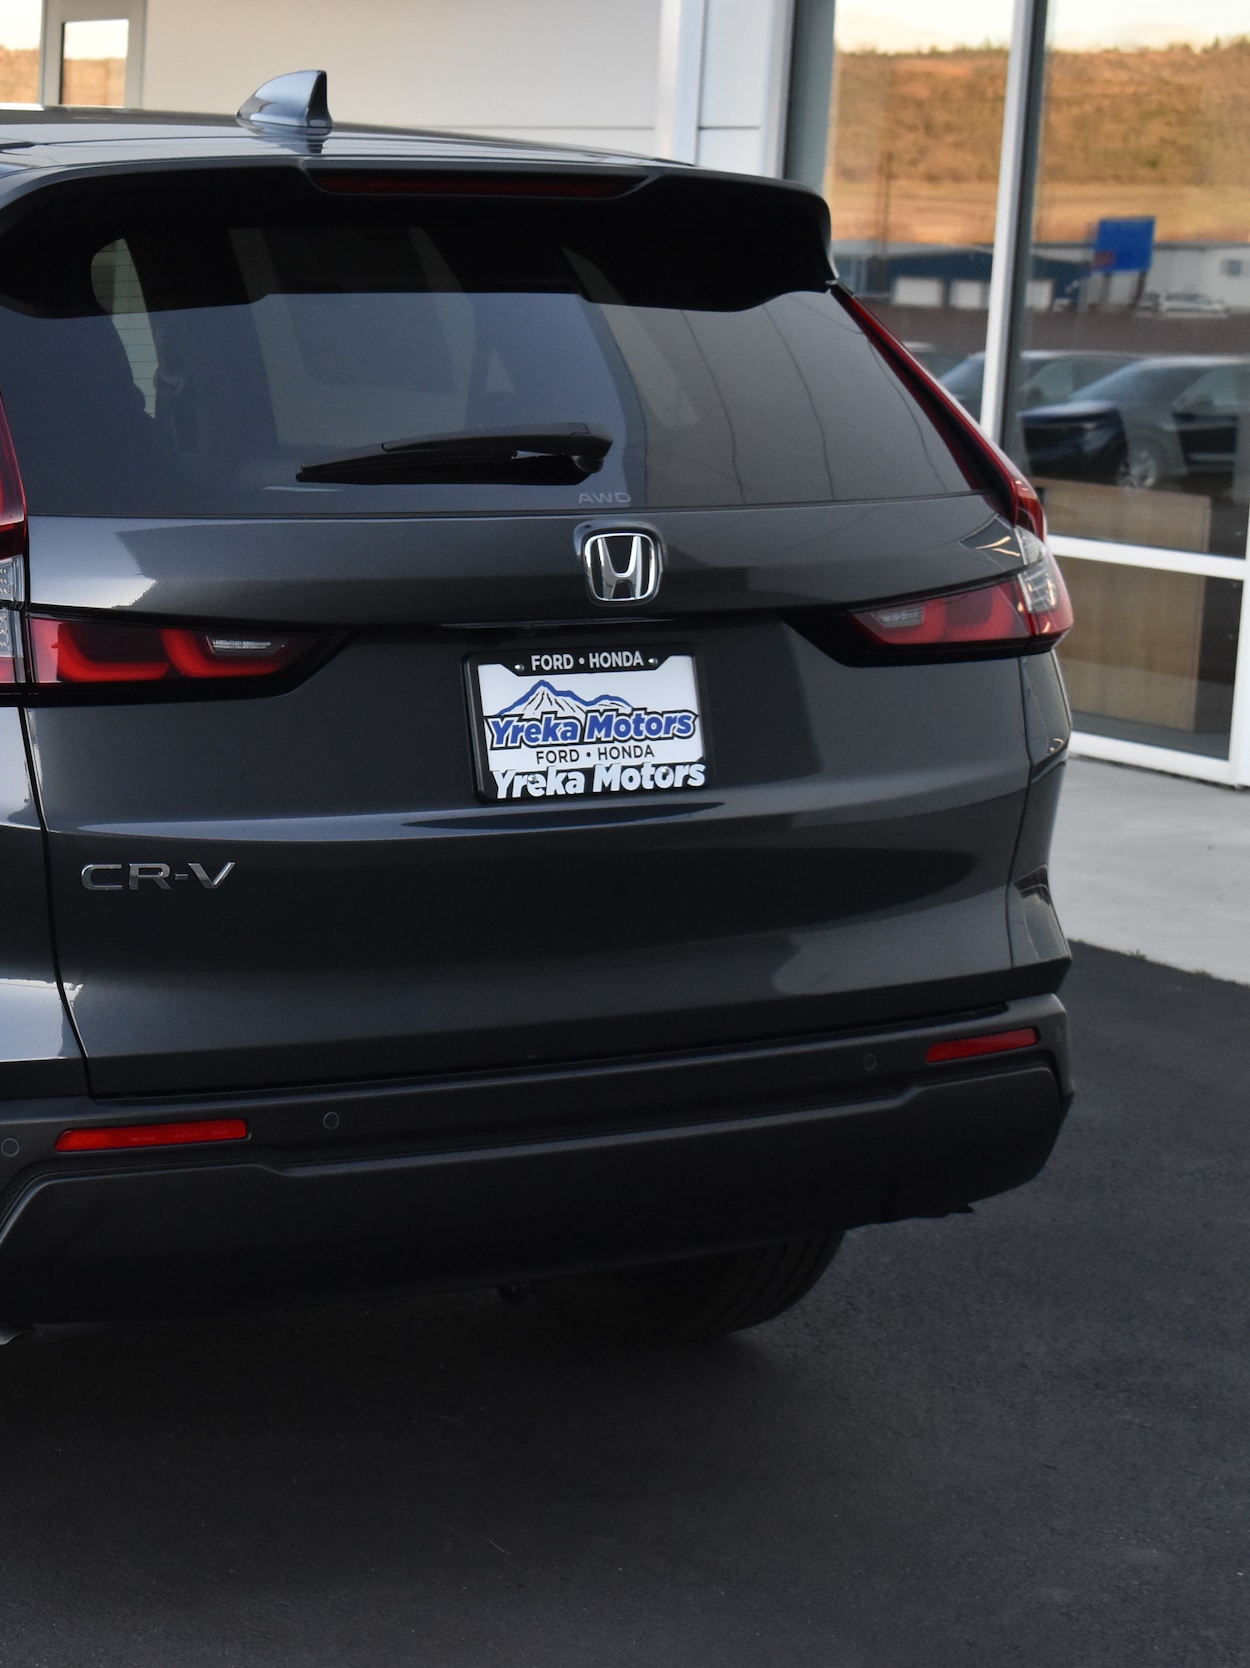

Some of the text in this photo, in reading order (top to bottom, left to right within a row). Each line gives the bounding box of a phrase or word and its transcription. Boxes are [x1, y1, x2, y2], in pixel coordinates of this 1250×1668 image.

[578, 492, 631, 504] AWD
[531, 650, 644, 671] FORD HONDA
[488, 710, 696, 748] Yreka Motors
[536, 744, 655, 764] FORD HONDA
[492, 763, 706, 799] Yreka Motors
[81, 861, 236, 891] CR-V
